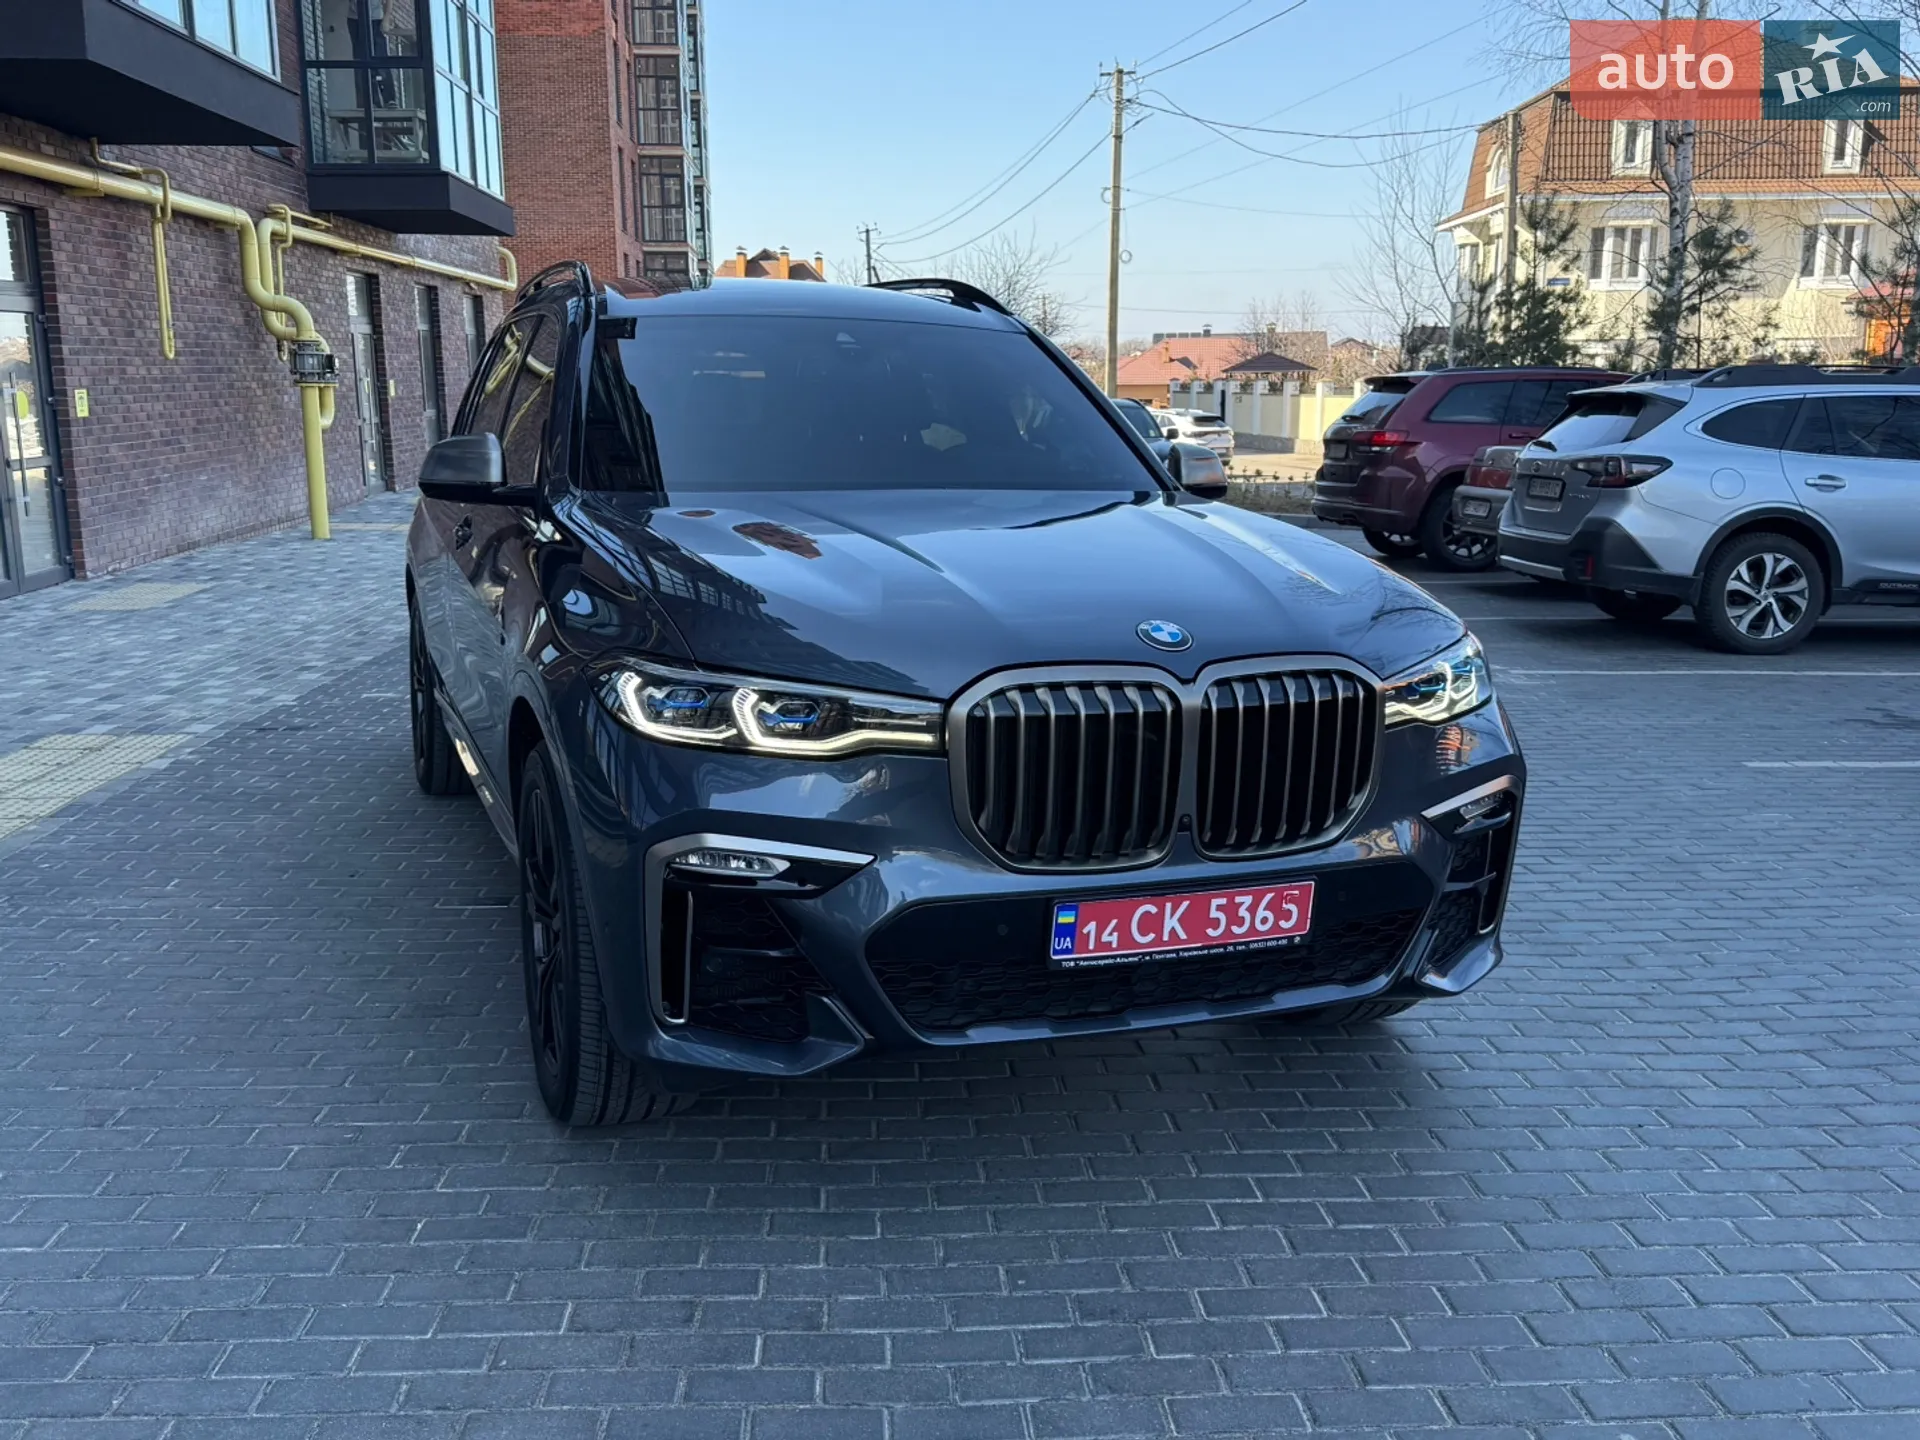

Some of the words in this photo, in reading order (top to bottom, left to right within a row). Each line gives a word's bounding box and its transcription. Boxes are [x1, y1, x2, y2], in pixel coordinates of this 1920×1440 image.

[1082, 919, 1119, 950] 14
[1131, 900, 1191, 944] CK
[1205, 890, 1300, 937] 5365
[1054, 937, 1072, 950] UA
